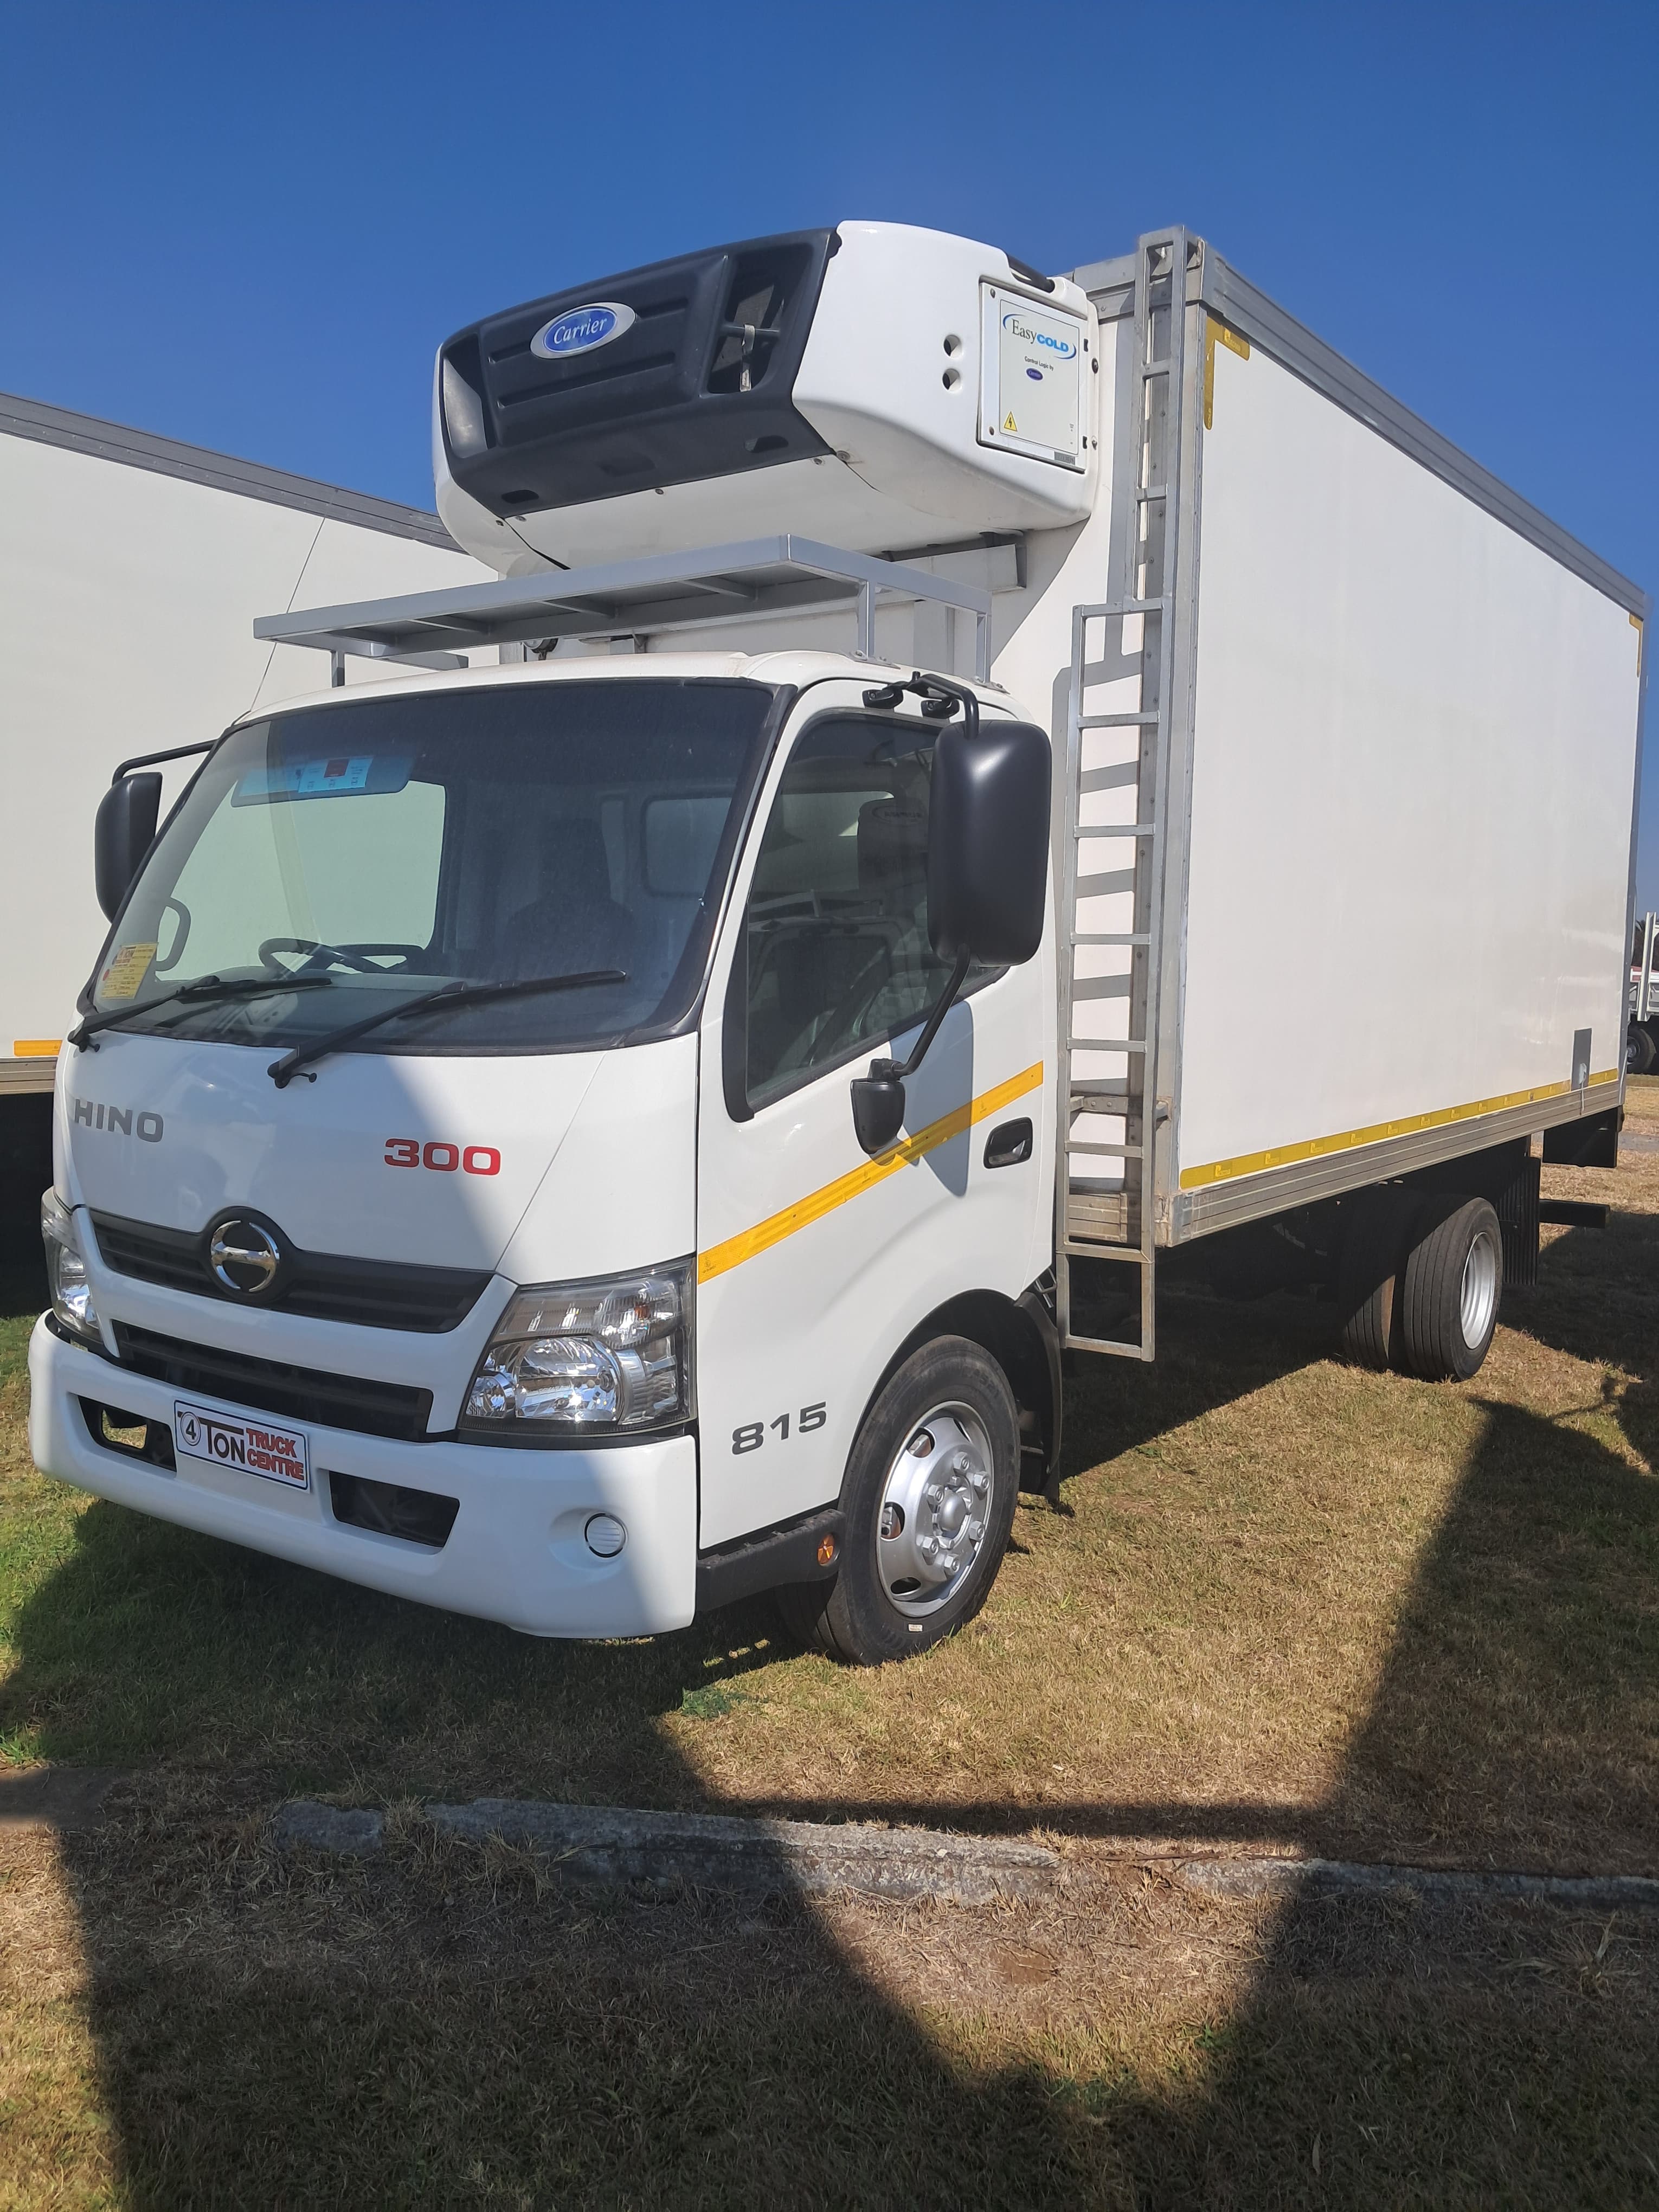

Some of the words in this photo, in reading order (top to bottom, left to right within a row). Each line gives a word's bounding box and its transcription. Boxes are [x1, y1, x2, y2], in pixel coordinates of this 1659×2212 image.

[553, 317, 607, 344] Carrier
[74, 1098, 164, 1143] HINO
[384, 1138, 501, 1176] 300
[197, 1416, 246, 1464] TON
[246, 1427, 297, 1458] TRUCK
[732, 1401, 827, 1455] 815
[247, 1448, 304, 1481] CENTRE
